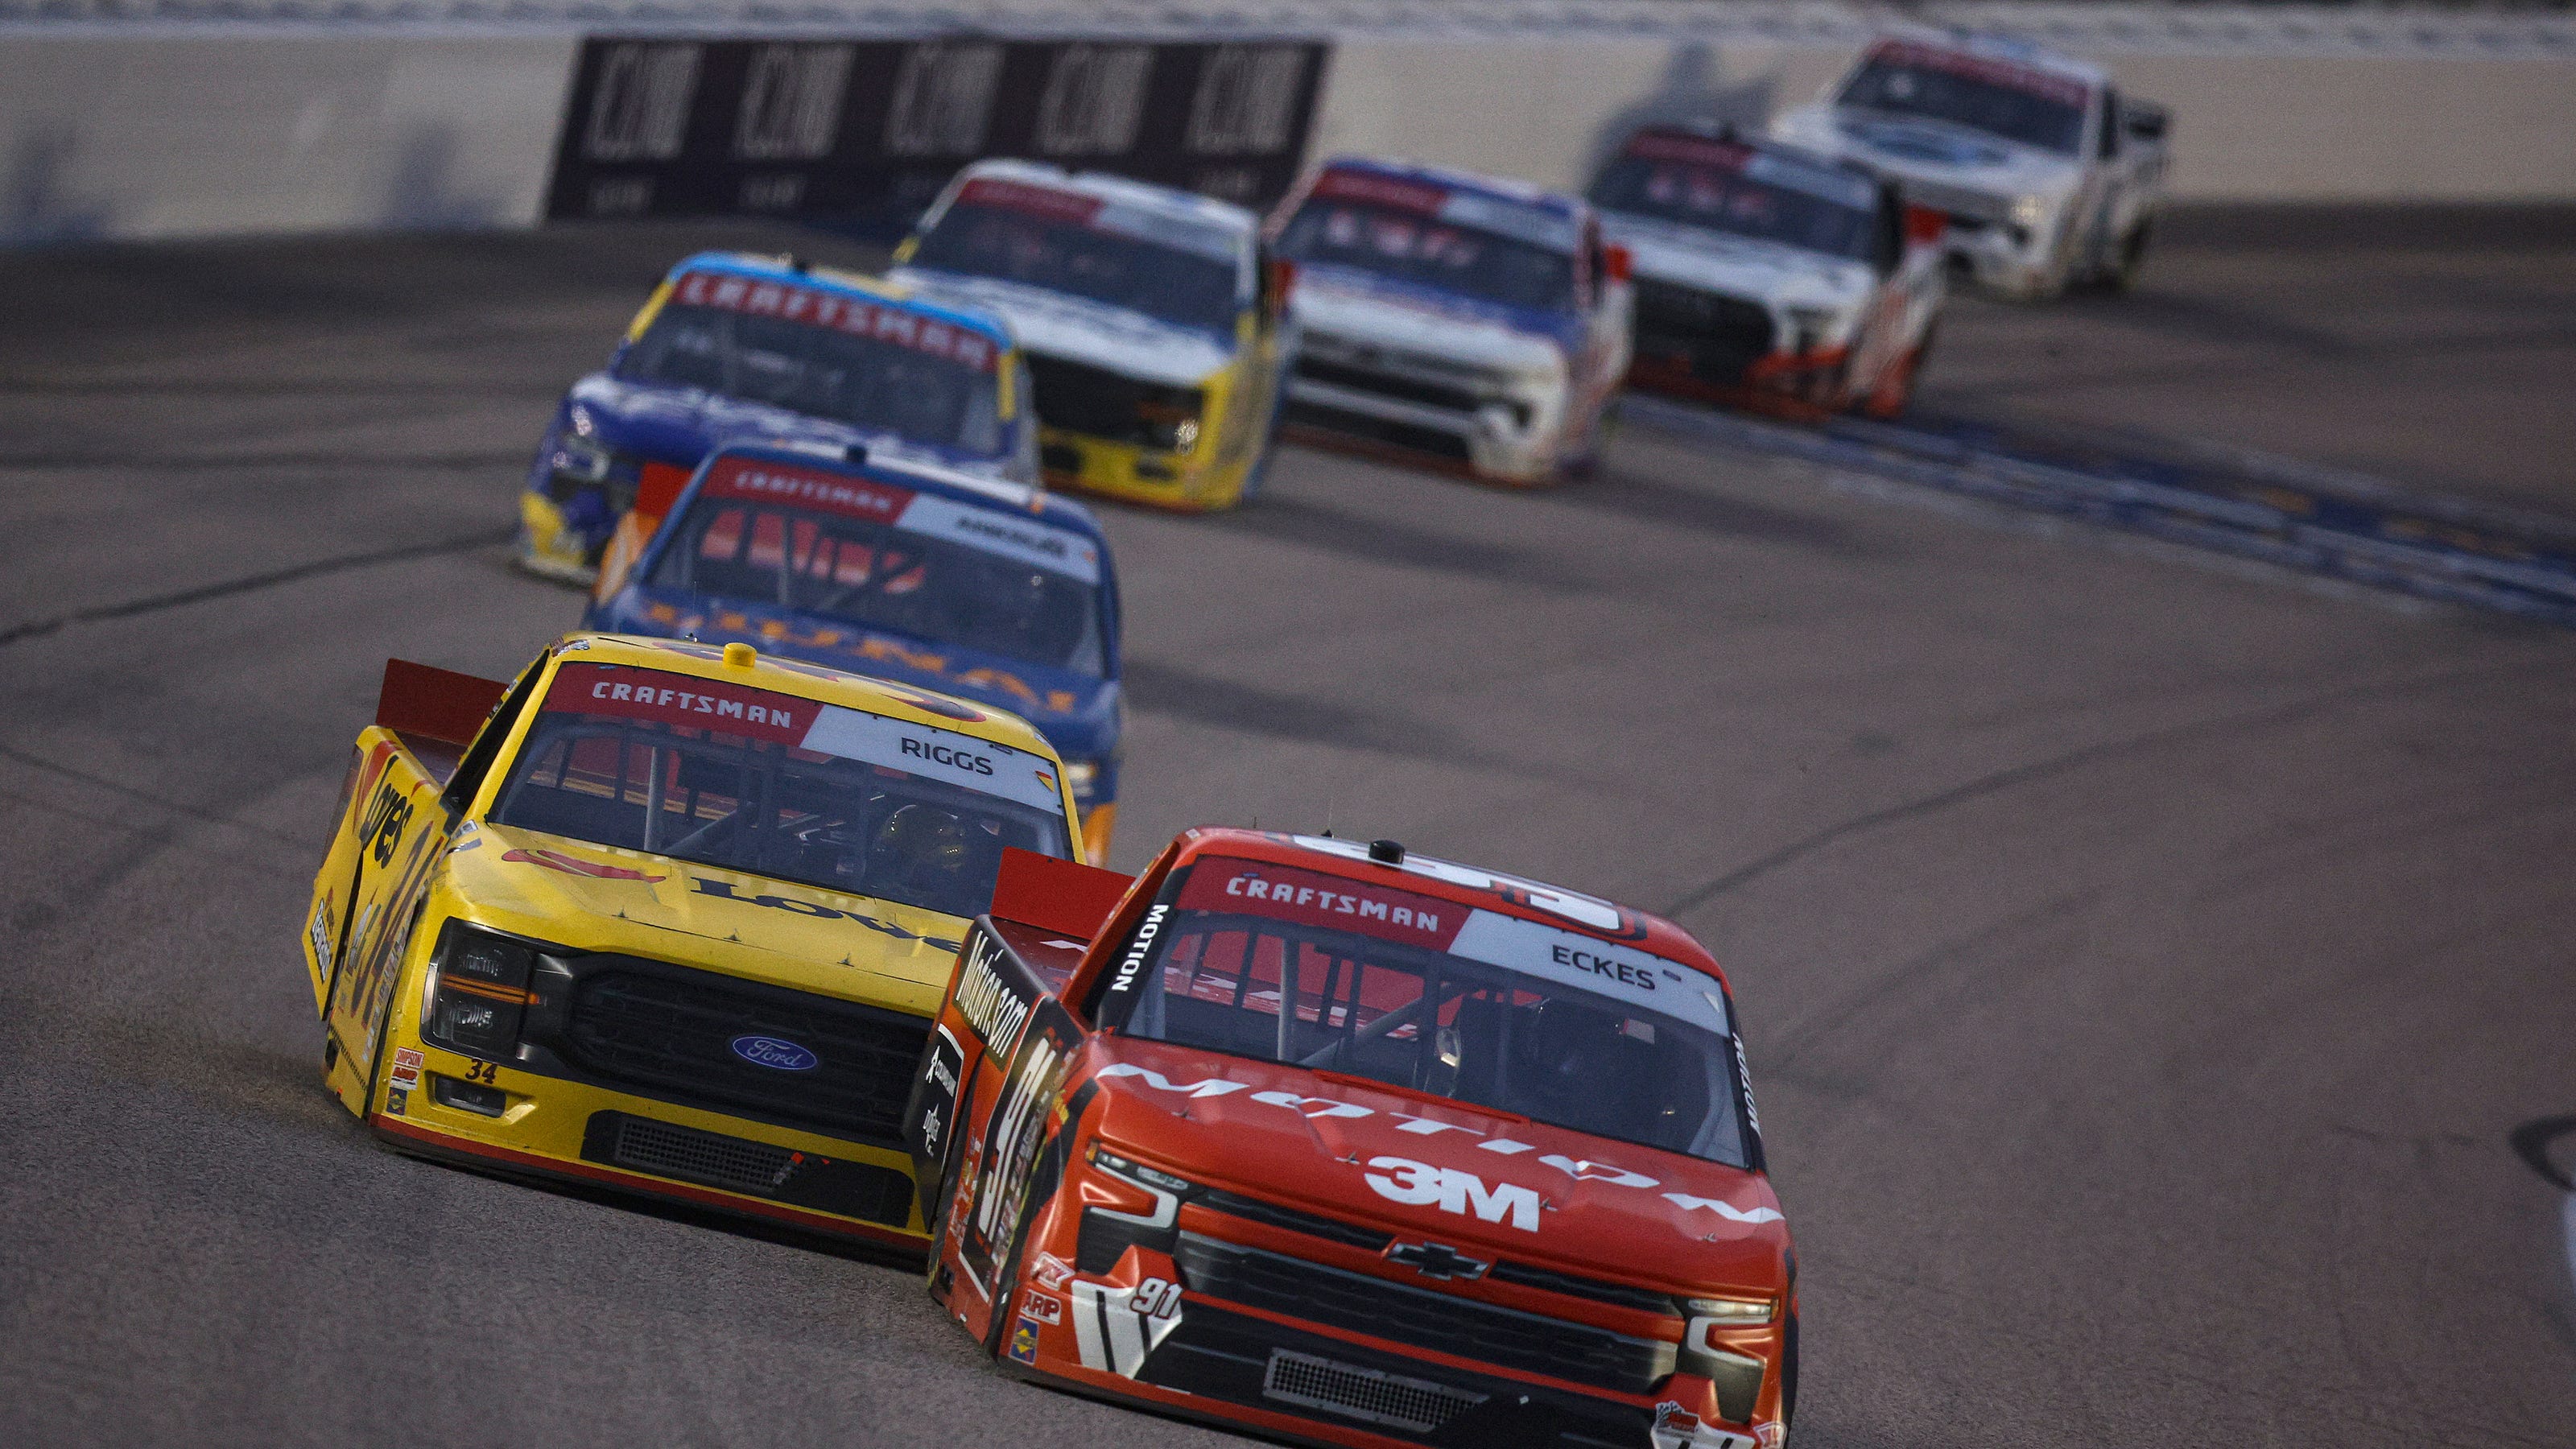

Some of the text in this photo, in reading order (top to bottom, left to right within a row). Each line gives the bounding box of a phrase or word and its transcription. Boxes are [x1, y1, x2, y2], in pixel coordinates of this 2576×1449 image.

[592, 681, 791, 729] CRAFTSMAN
[901, 736, 994, 776] RIGGS
[1226, 876, 1439, 933] CRAFTSMAN
[1111, 904, 1170, 992] MOTION
[1552, 944, 1655, 991] ECKES
[396, 1048, 423, 1067] SIMPSON
[464, 1057, 499, 1085] 34
[746, 1039, 804, 1067] Ford
[1096, 1062, 1786, 1224] MOTION
[1364, 1156, 1540, 1232] 3M
[1129, 1277, 1183, 1320] 91
